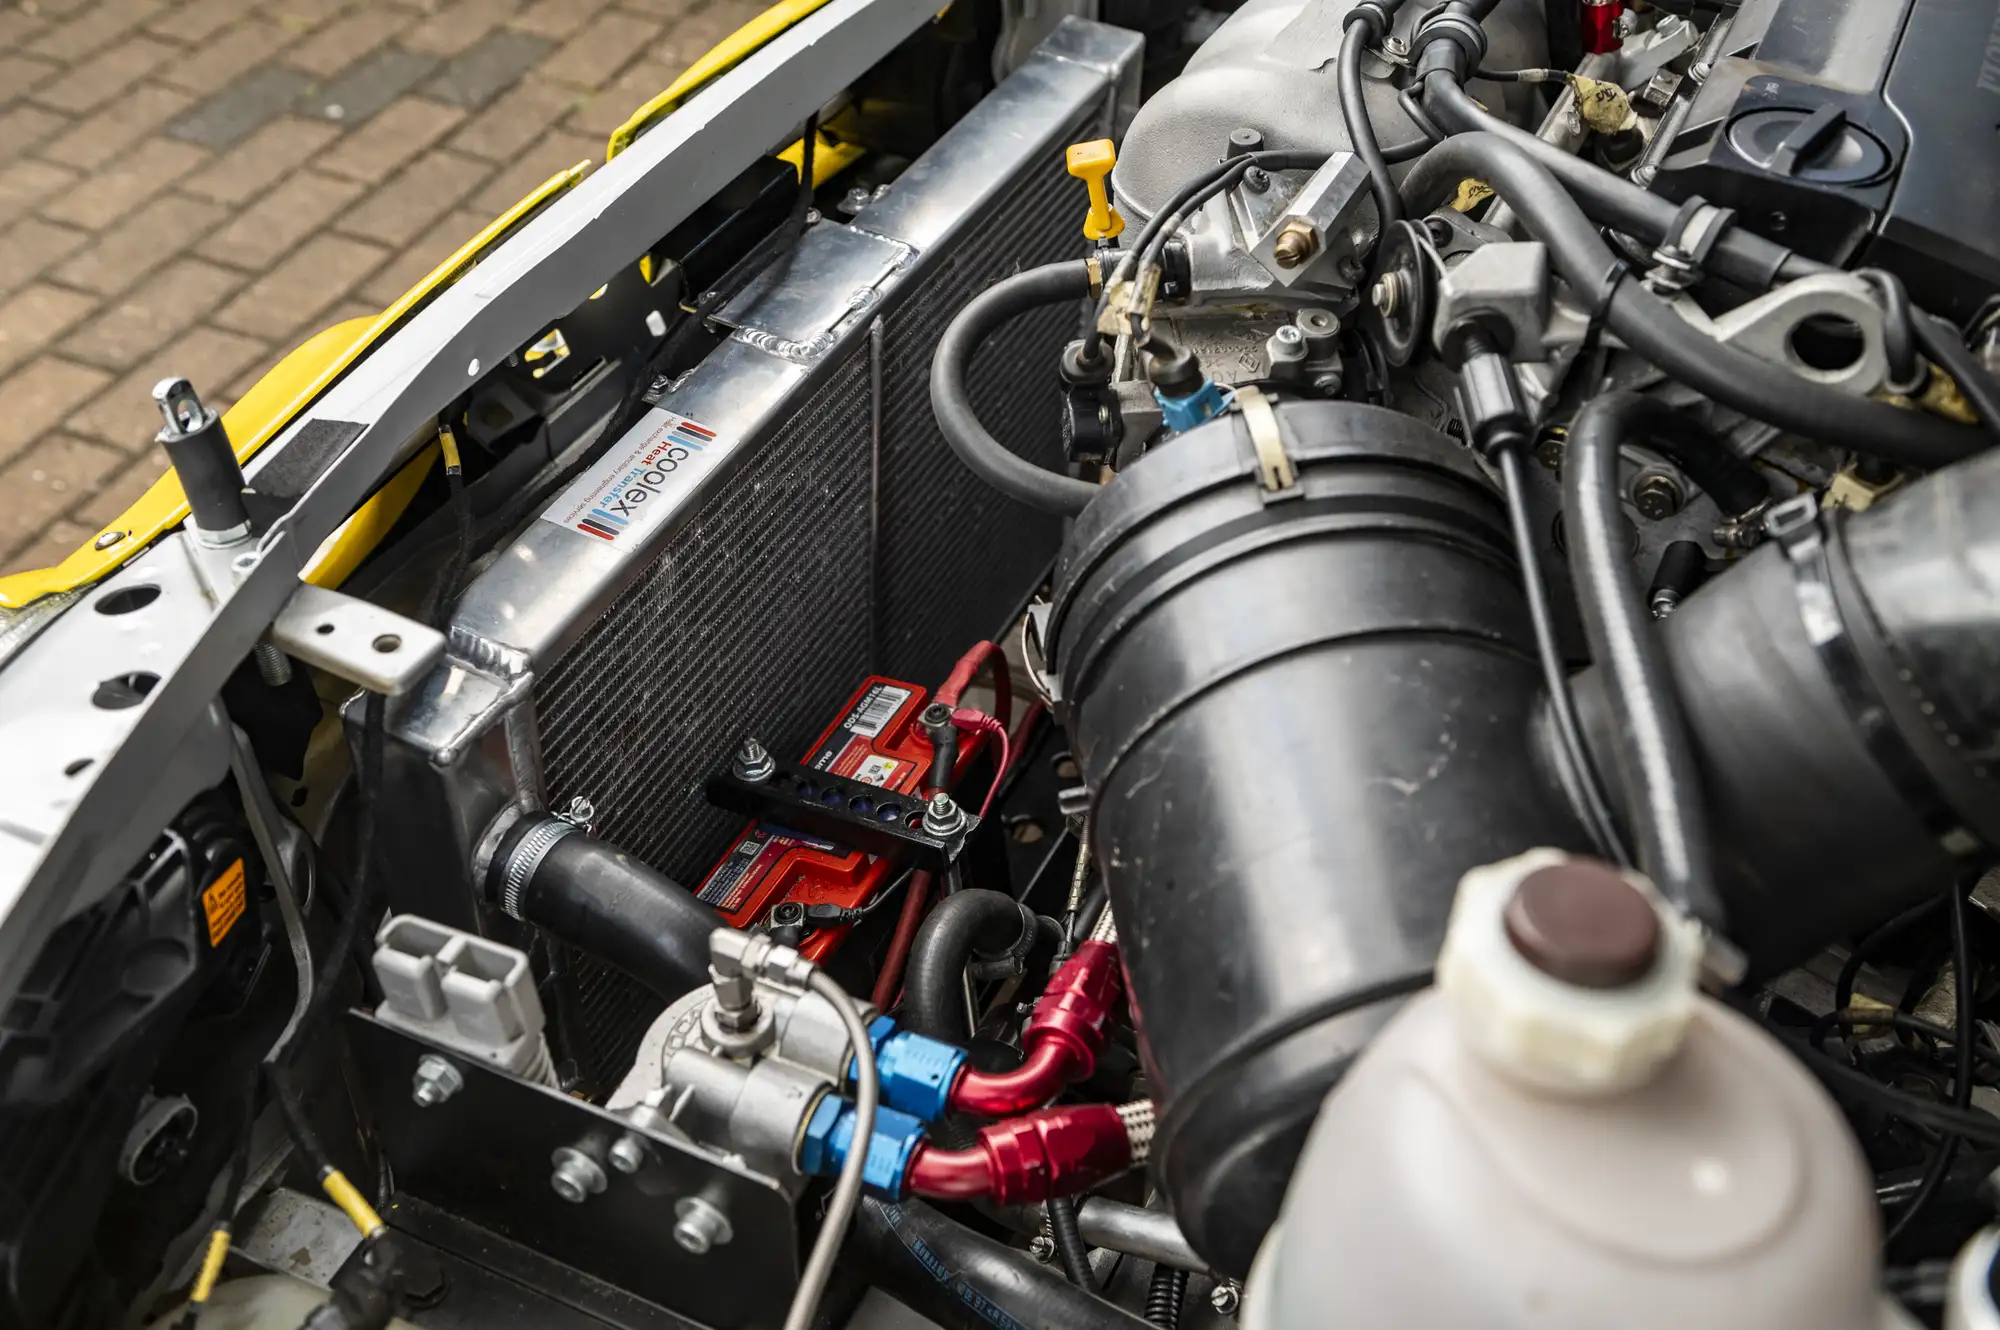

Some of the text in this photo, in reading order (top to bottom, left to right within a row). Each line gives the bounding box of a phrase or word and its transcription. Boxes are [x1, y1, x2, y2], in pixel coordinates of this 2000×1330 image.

[641, 441, 672, 465] Heat
[584, 474, 615, 503] engineering
[600, 467, 648, 508] Transfer
[610, 448, 689, 517] coolex
[563, 503, 586, 523] services
